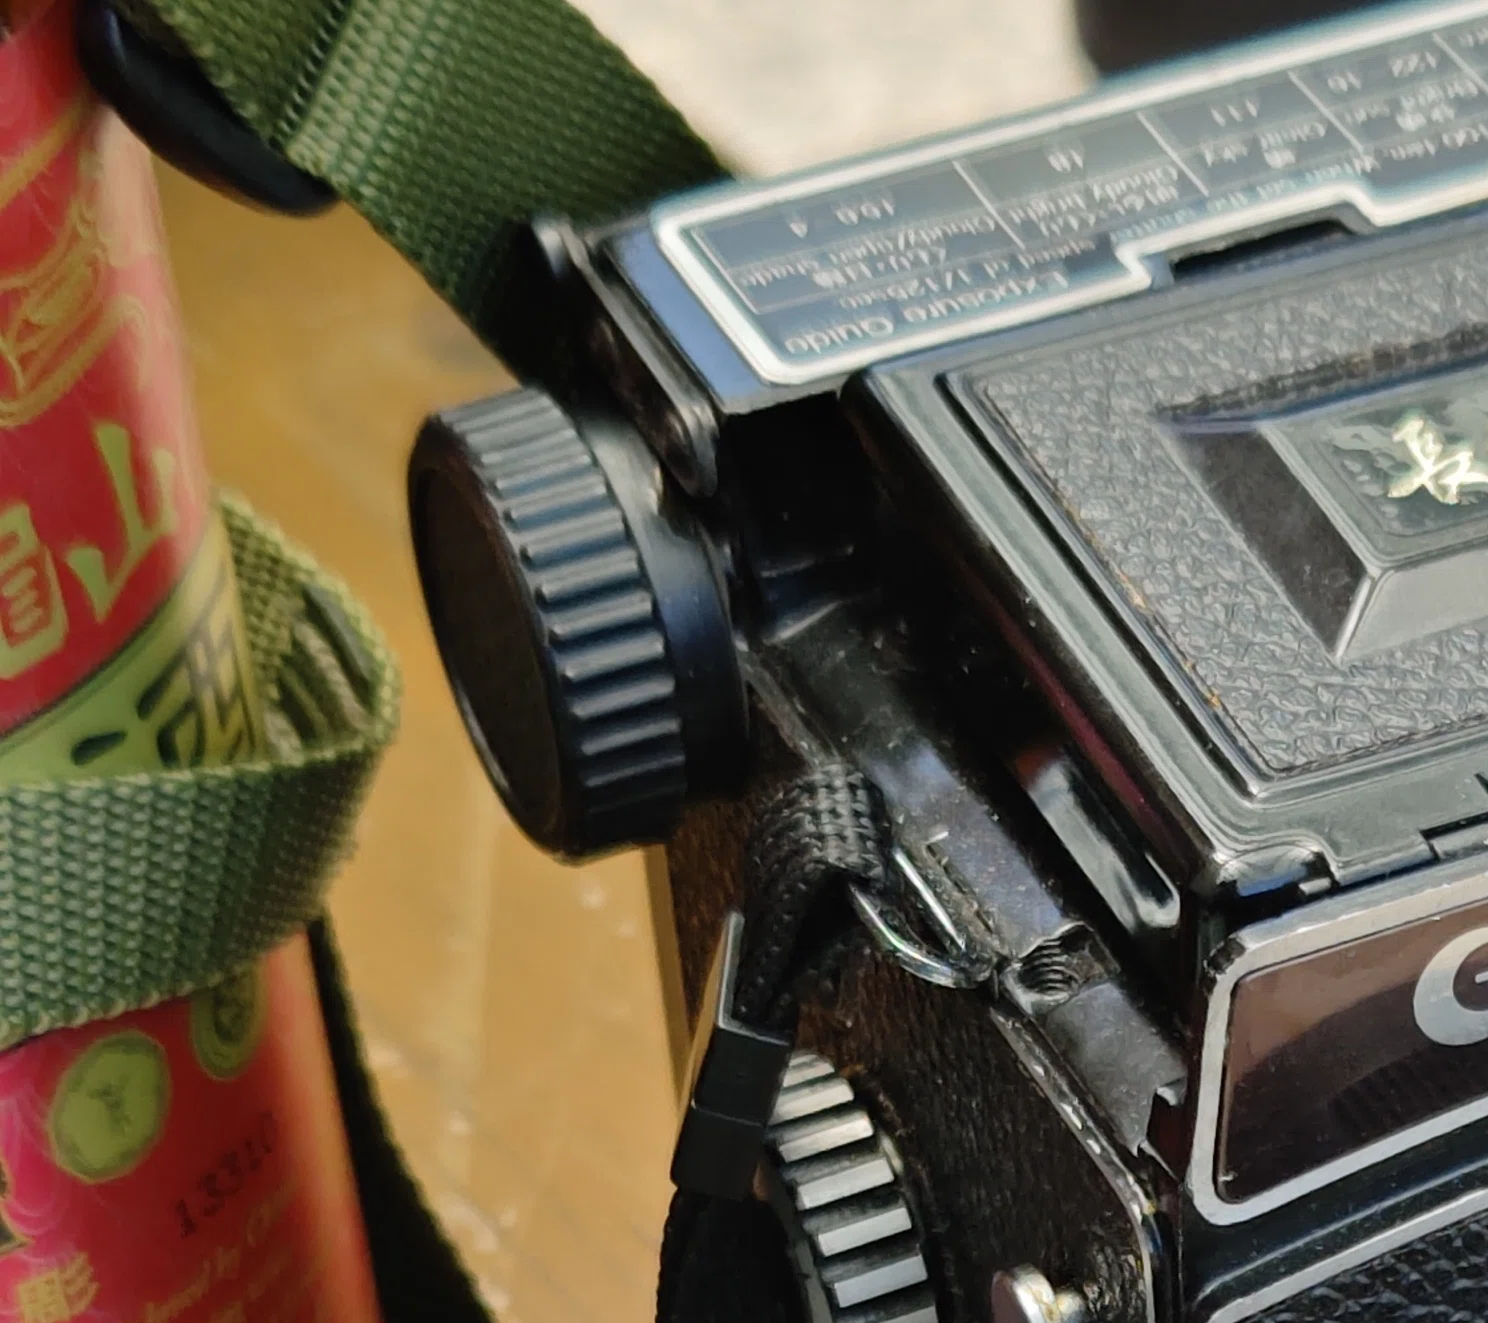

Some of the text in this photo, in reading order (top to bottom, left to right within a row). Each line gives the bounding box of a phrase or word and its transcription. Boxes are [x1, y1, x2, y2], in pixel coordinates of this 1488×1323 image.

[1086, 166, 1181, 197] Cloudy
[782, 269, 1068, 356] Exposure Guide
